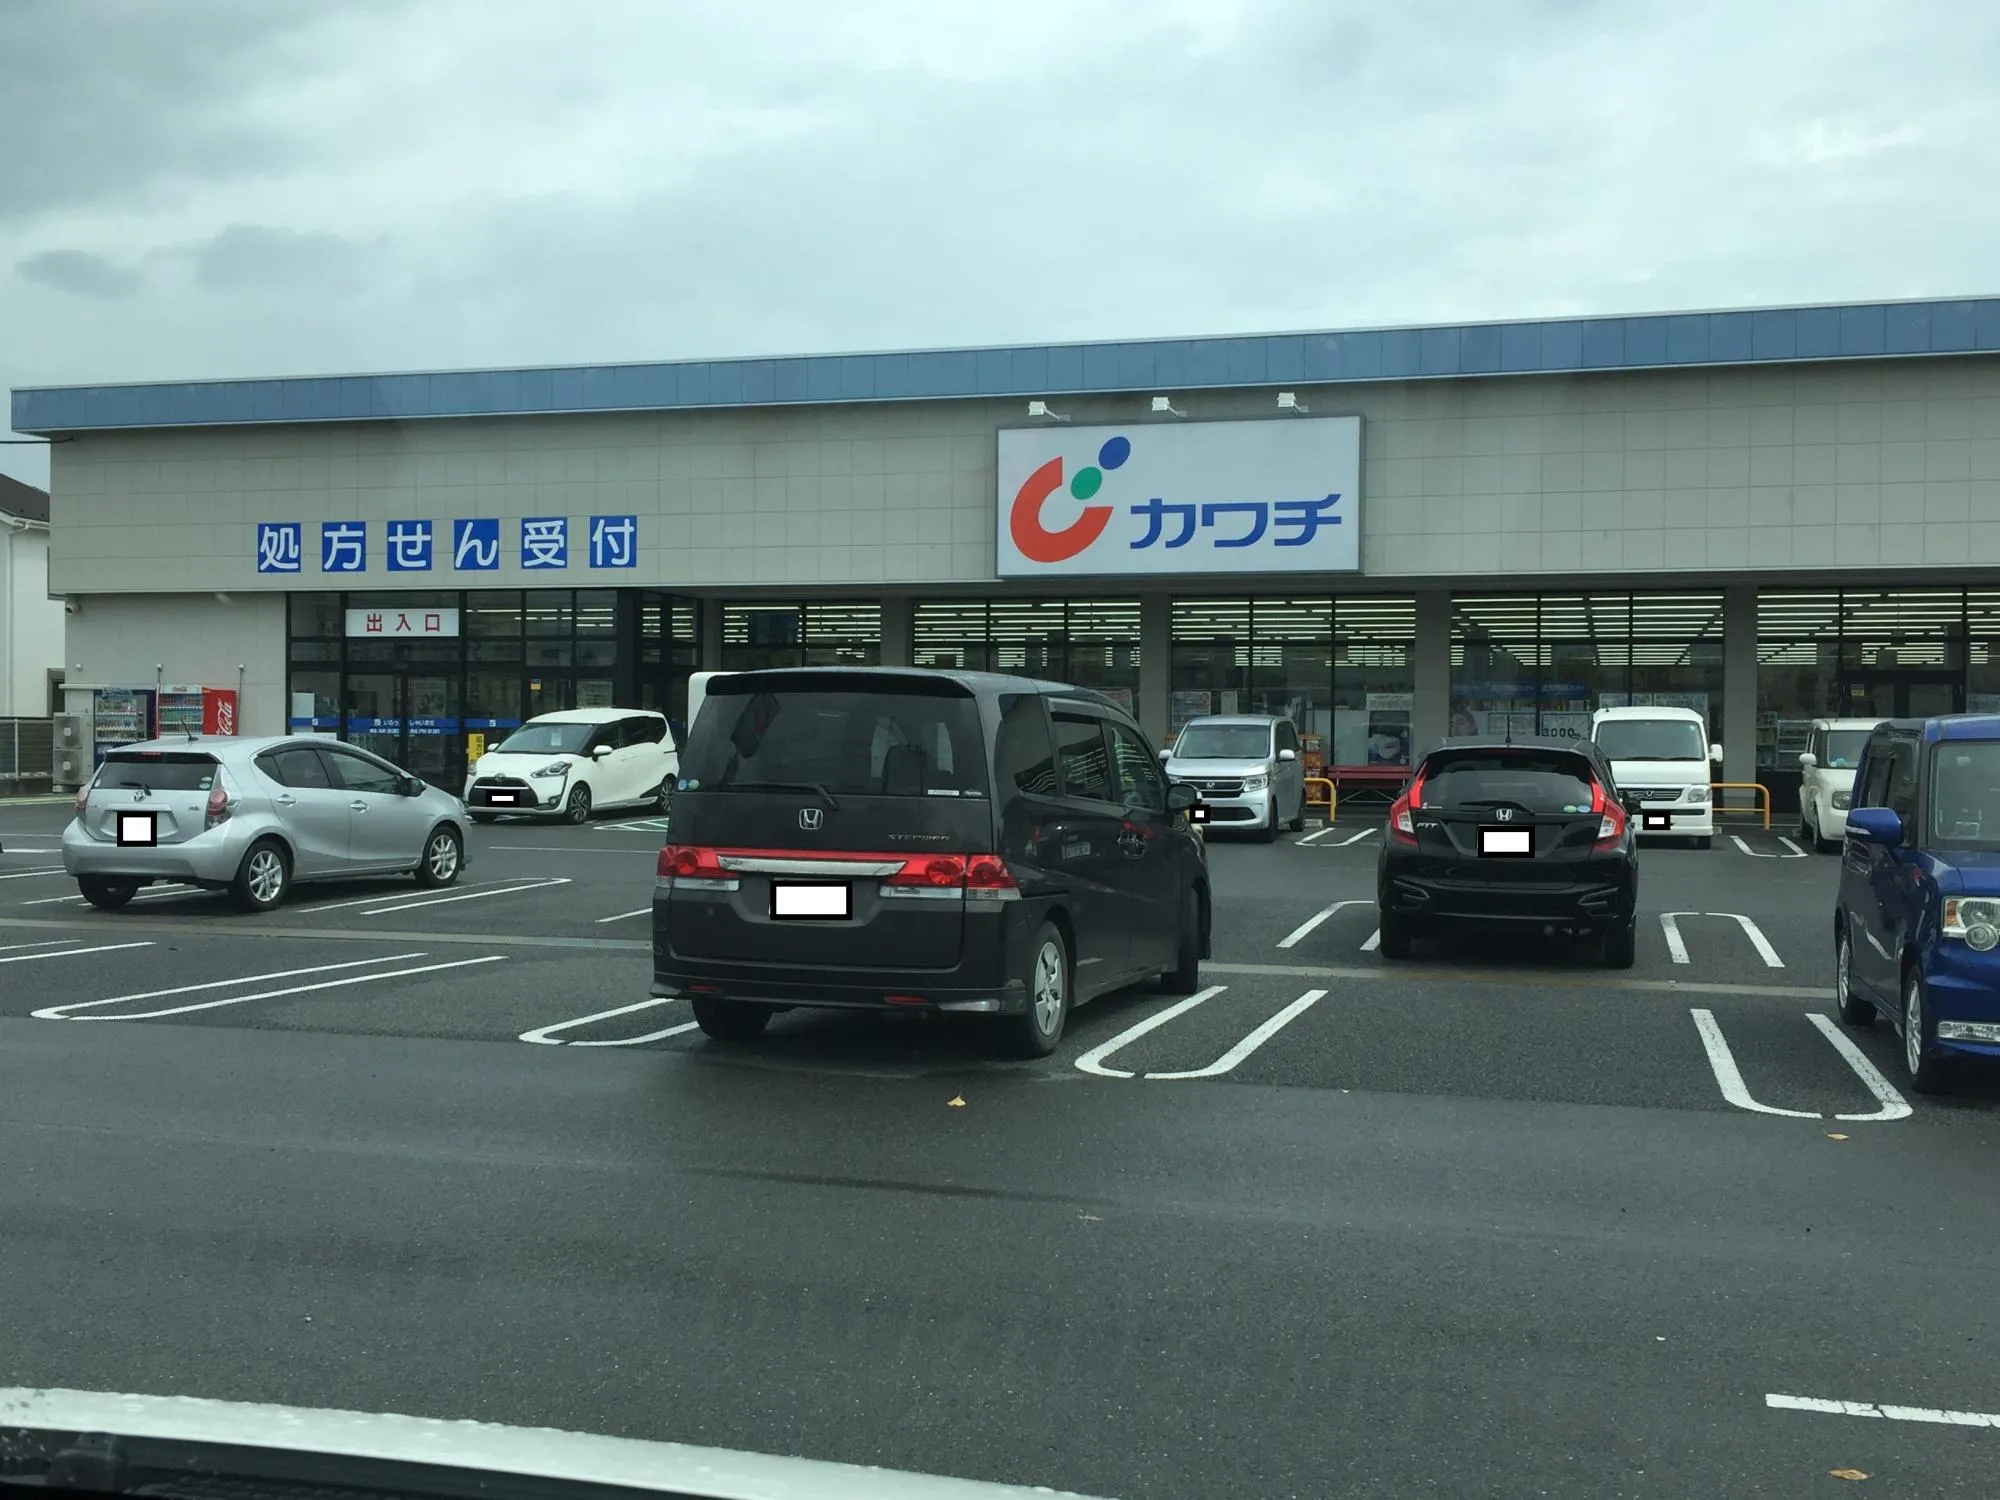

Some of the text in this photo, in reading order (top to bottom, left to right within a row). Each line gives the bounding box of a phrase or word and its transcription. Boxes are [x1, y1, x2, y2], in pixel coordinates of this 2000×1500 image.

[259, 517, 635, 571] 処方せん受付
[1129, 493, 1342, 549] カワチ
[366, 613, 441, 633] 出入口
